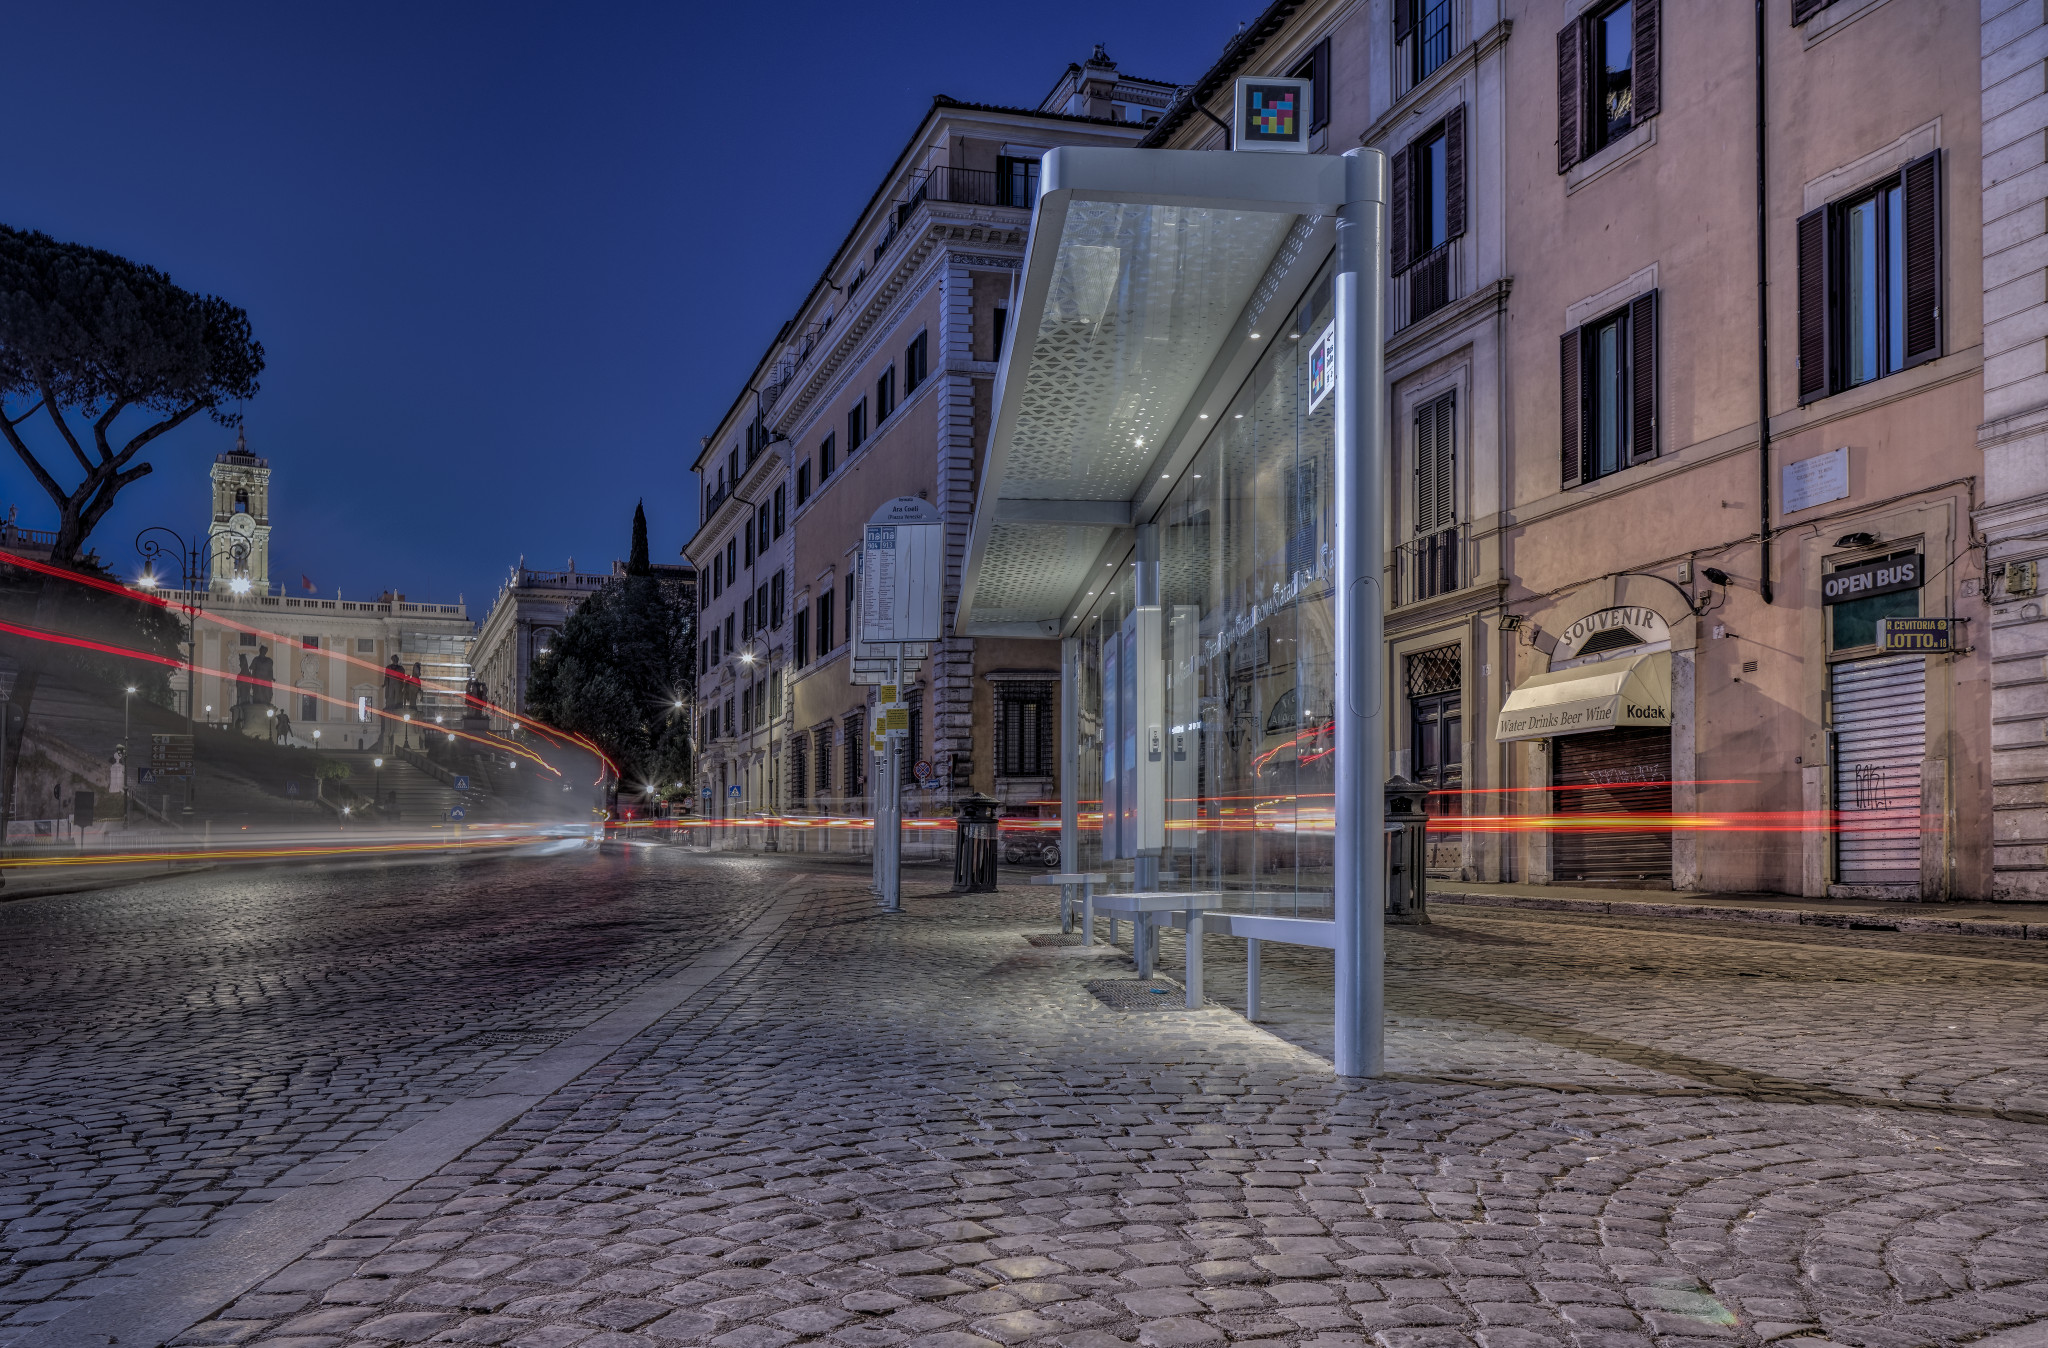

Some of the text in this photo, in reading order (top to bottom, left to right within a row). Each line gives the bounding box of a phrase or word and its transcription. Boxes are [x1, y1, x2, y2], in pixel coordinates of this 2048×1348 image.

[1824, 563, 1915, 598] OPEN BUS
[1563, 608, 1655, 647] SOUVENIR
[1886, 619, 1936, 632] RCEVITORIA
[1886, 633, 1934, 648] LOTTO
[1939, 638, 1947, 648] 18
[1500, 706, 1613, 734] Water Drinks Beer Wine
[1626, 704, 1666, 719] Kodak
